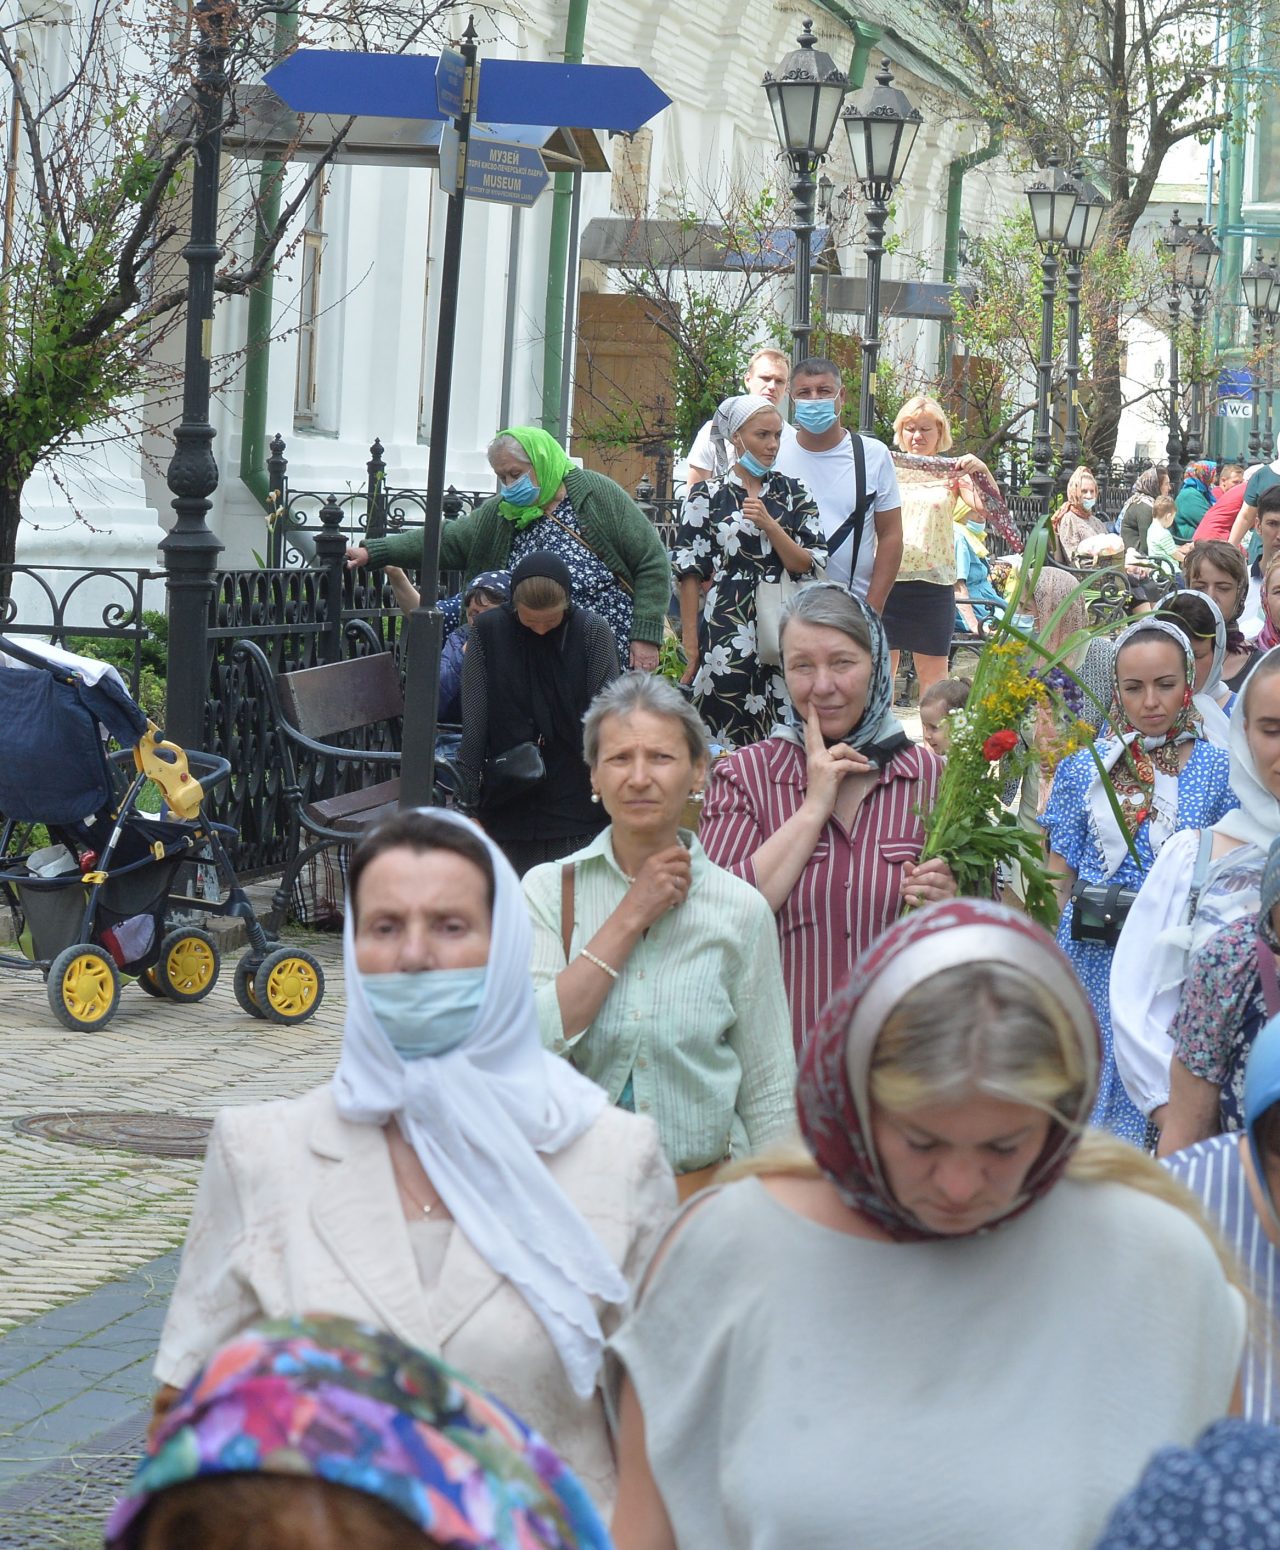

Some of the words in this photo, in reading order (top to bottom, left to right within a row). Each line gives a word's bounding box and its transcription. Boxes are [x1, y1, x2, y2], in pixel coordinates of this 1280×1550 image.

[490, 149, 519, 165] МУЗЕЙ
[483, 174, 521, 190] MUSEUM
[1229, 405, 1250, 416] WC
